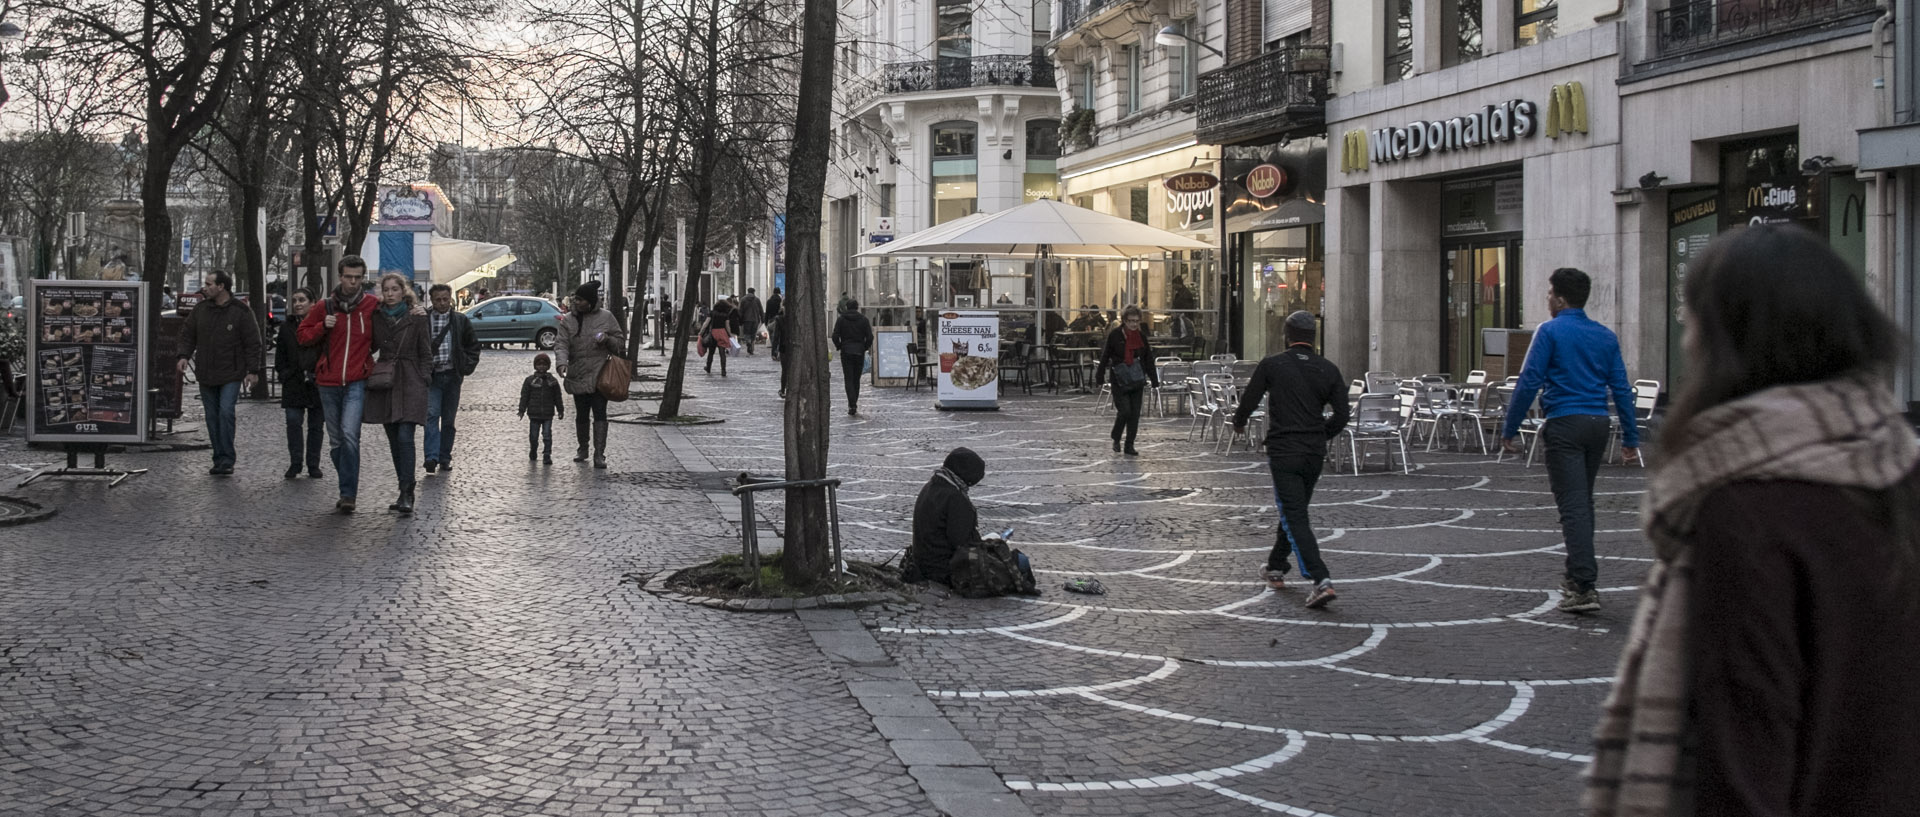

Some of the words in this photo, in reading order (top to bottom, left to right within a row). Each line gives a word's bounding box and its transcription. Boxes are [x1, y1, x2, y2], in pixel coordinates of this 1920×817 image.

[1371, 99, 1537, 163] McDonald's
[1175, 176, 1210, 190] Nabab
[1251, 168, 1275, 191] Nabab
[1025, 187, 1054, 200] Sogood
[1674, 199, 1716, 224] NOUVEAU
[75, 423, 98, 431] GUR
